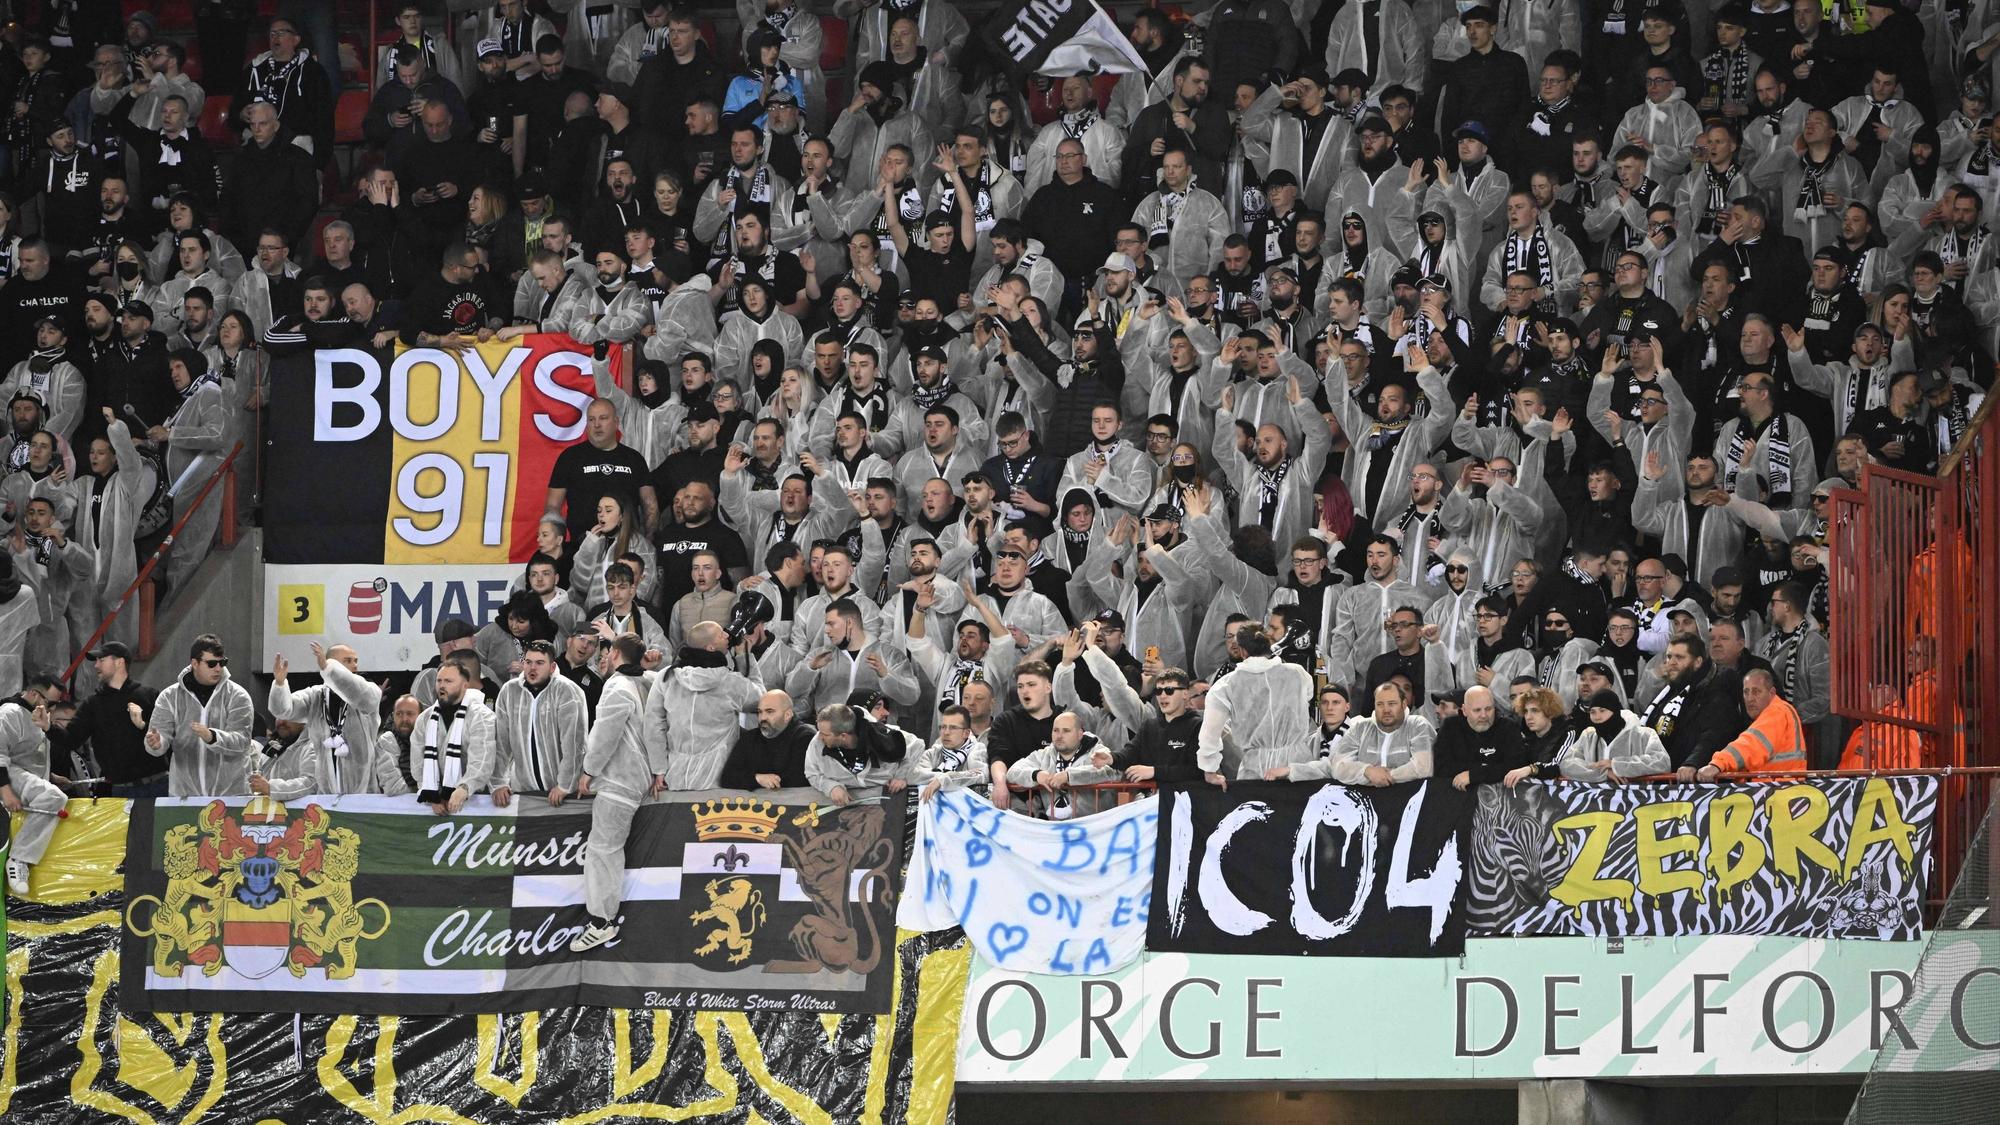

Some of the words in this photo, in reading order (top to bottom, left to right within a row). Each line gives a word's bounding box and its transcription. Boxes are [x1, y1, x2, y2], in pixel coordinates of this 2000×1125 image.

[313, 347, 595, 441] BOYS
[392, 452, 510, 545] 91
[292, 596, 310, 623] 3
[389, 580, 508, 634] MAE
[428, 821, 591, 869] Münste
[1548, 778, 1918, 919] ZEBRA
[1027, 891, 1083, 929] ON
[423, 909, 625, 967] Charleri
[1050, 937, 1110, 973] LA
[643, 991, 681, 1007] Black
[686, 992, 698, 1007] &
[700, 993, 740, 1009] White
[744, 994, 786, 1009] Storm
[790, 993, 837, 1010] Ultras
